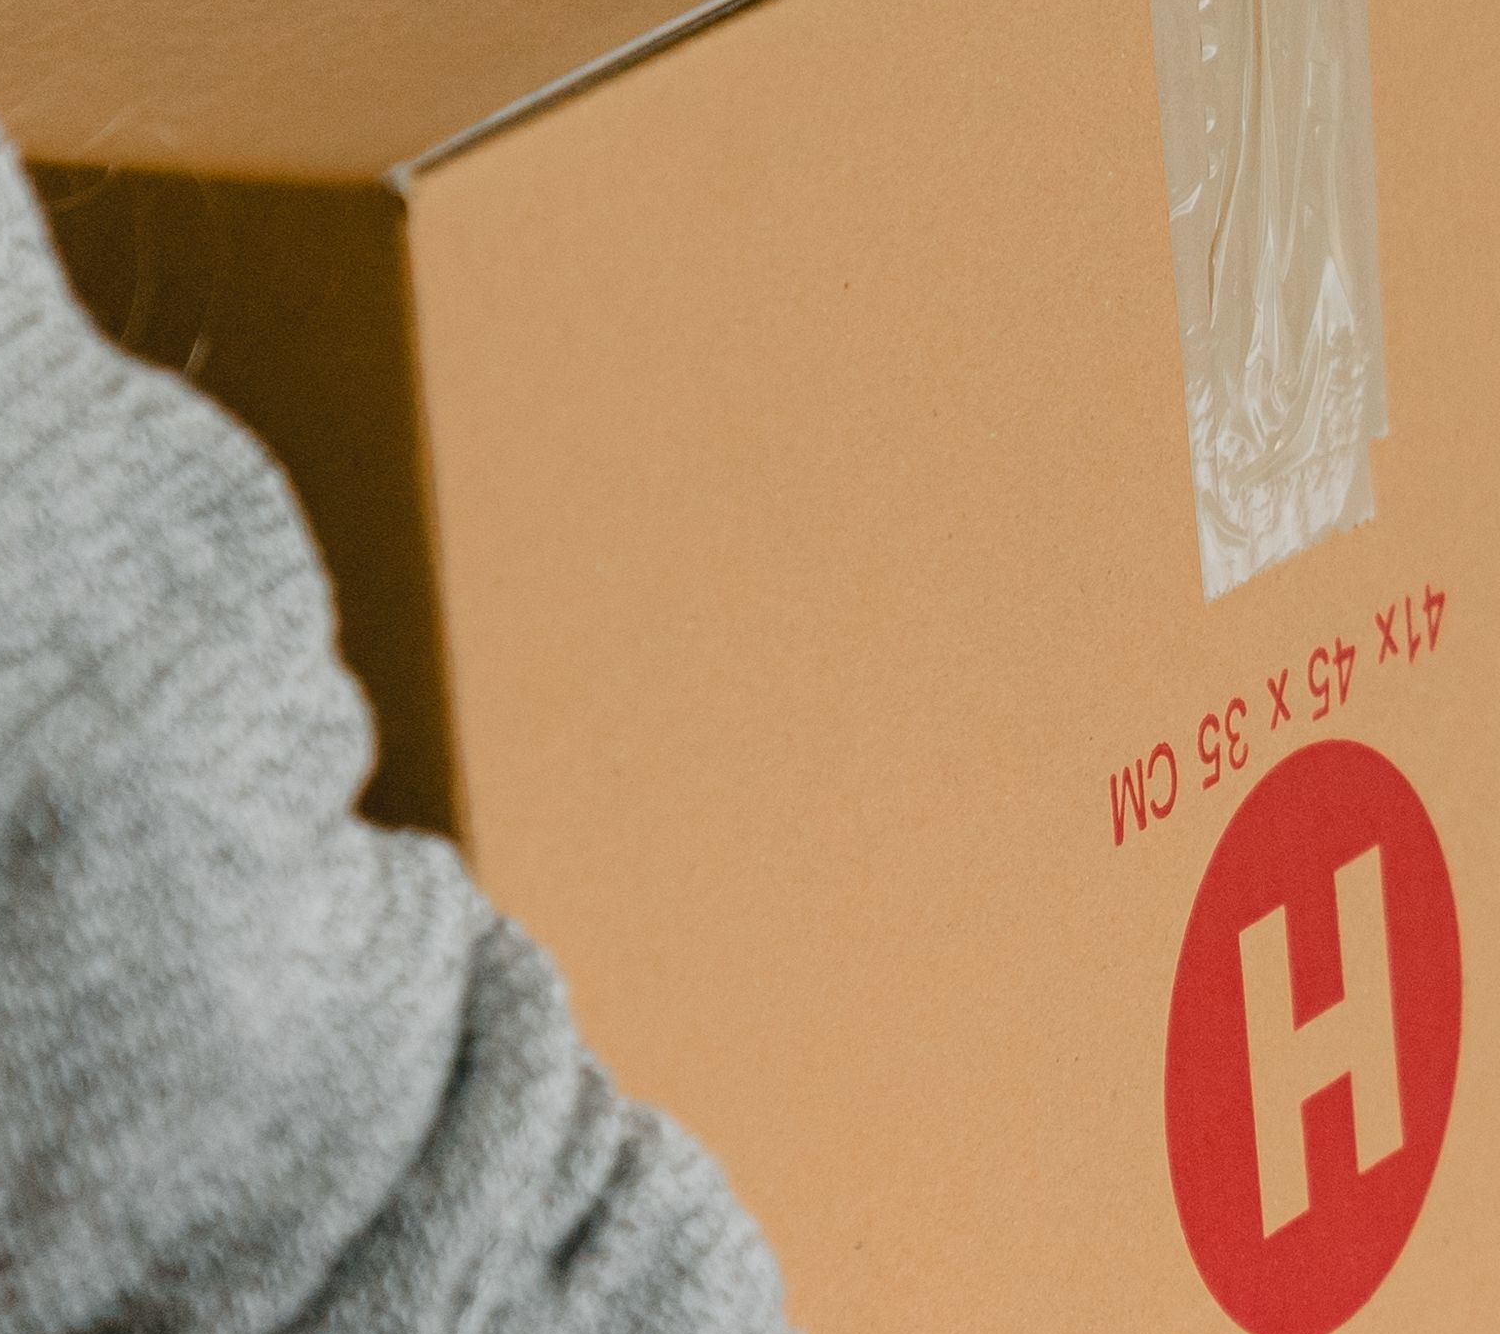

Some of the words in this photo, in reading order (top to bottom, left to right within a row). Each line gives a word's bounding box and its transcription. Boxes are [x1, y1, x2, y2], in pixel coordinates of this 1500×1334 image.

[1307, 636, 1357, 722] 45
[1196, 696, 1250, 790] 35
[1109, 741, 1179, 846] CM
[1238, 843, 1404, 1240] H
